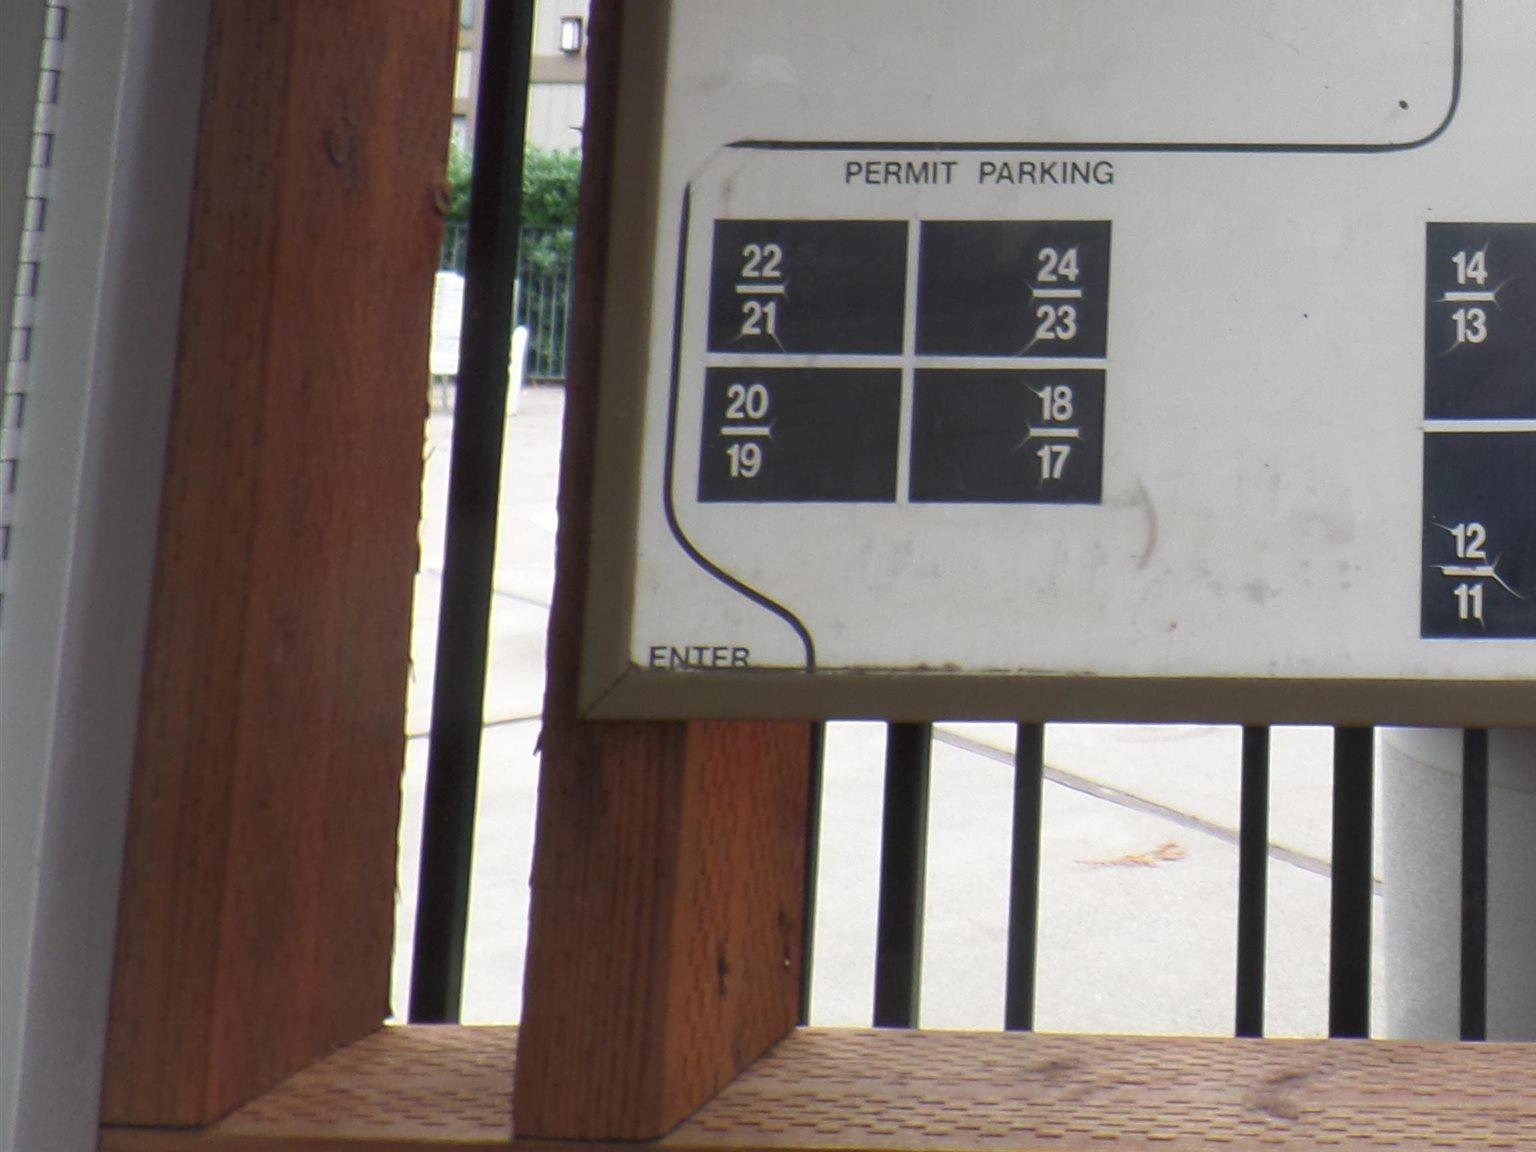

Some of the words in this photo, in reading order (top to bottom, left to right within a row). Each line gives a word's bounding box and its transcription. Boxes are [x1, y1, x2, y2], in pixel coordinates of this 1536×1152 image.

[846, 161, 958, 186] PERMIT
[978, 161, 1115, 186] PARKING
[742, 244, 782, 278] 22
[1037, 247, 1079, 282] 24
[1452, 250, 1487, 285] 14
[740, 302, 777, 335] 21
[1035, 306, 1077, 341] 23
[1452, 307, 1487, 344] 13
[727, 385, 769, 419] 20
[1037, 386, 1073, 420] 18
[726, 444, 762, 479] 19
[1037, 445, 1070, 481] 17
[1452, 524, 1487, 558] 12
[1454, 586, 1484, 620] 11
[649, 646, 749, 669] ENTER
